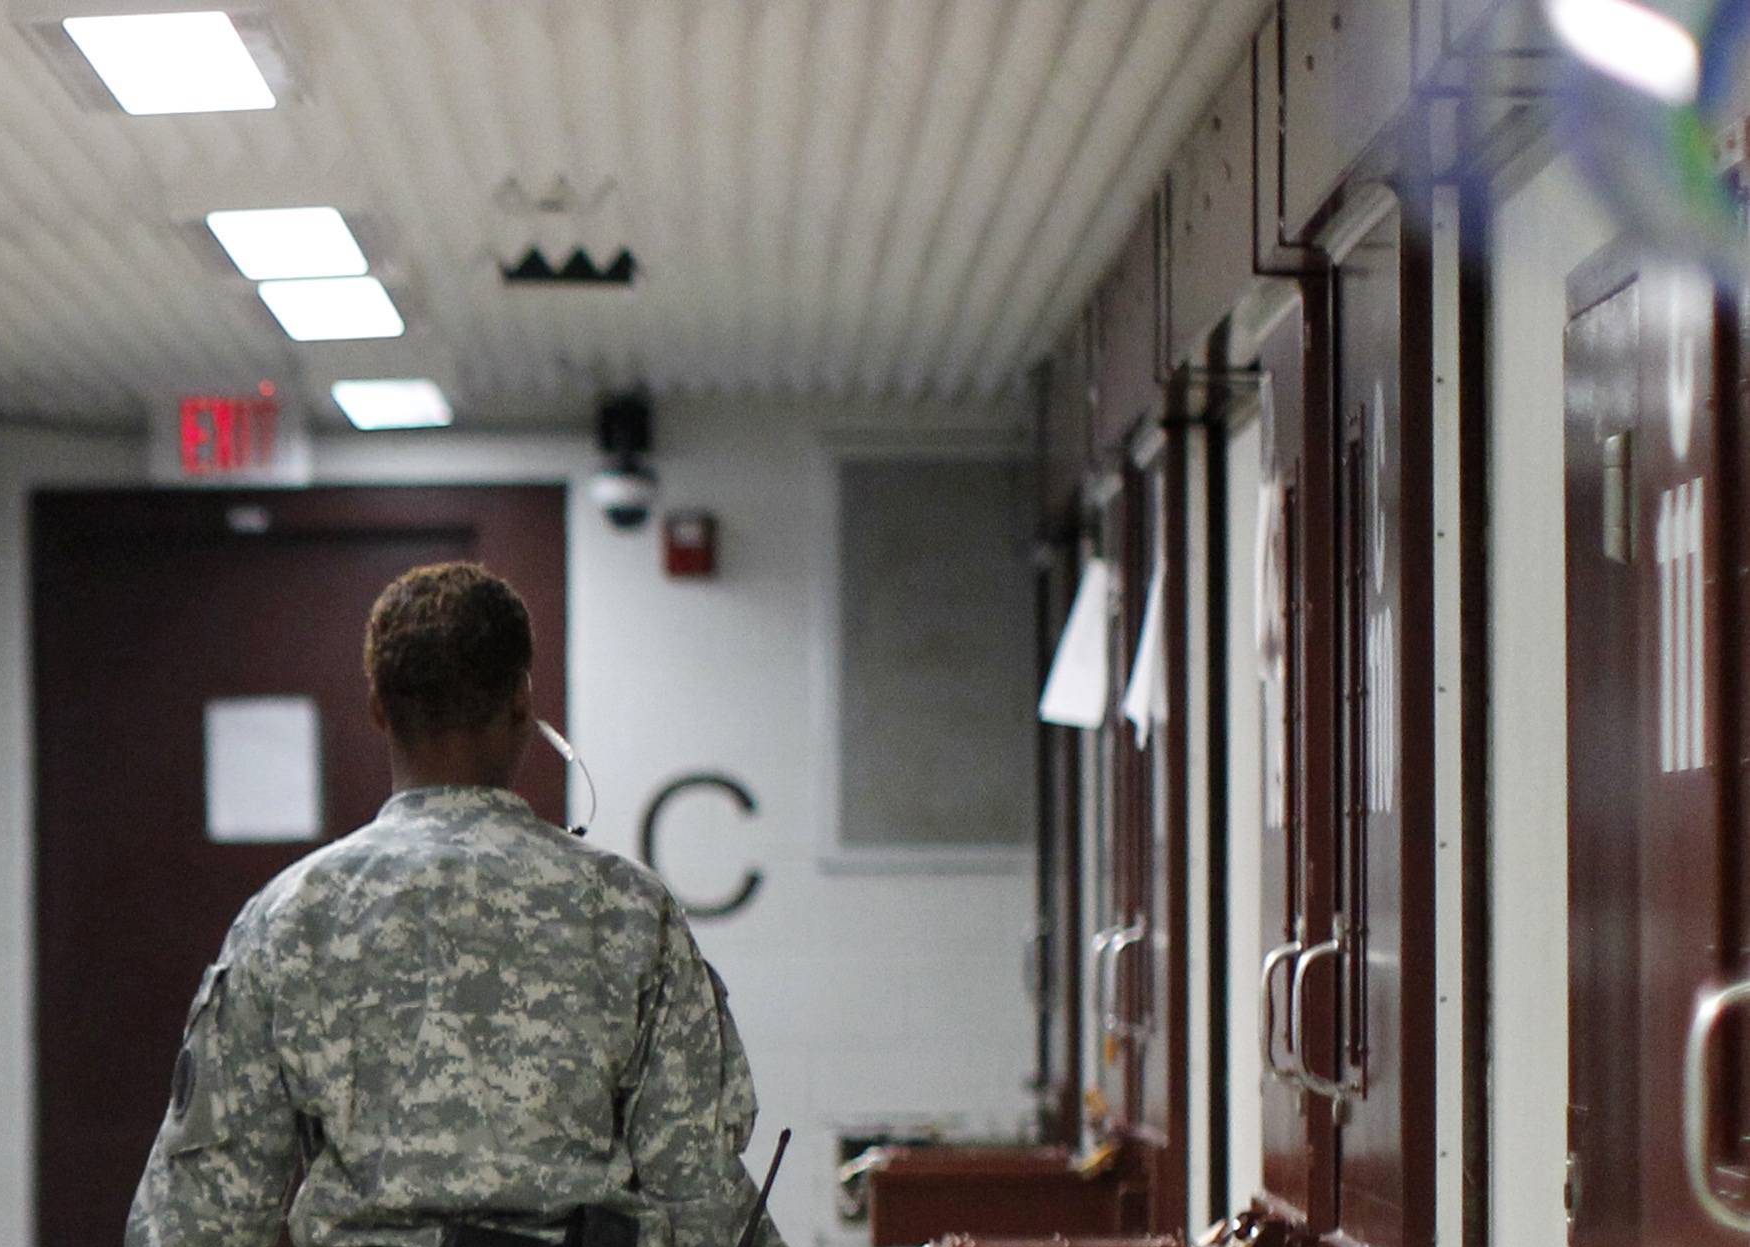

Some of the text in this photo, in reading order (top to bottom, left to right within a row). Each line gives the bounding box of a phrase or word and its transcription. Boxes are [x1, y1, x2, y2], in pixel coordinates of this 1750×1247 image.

[180, 396, 277, 475] EXIT
[1655, 476, 1705, 773] 111
[638, 771, 764, 920] C
